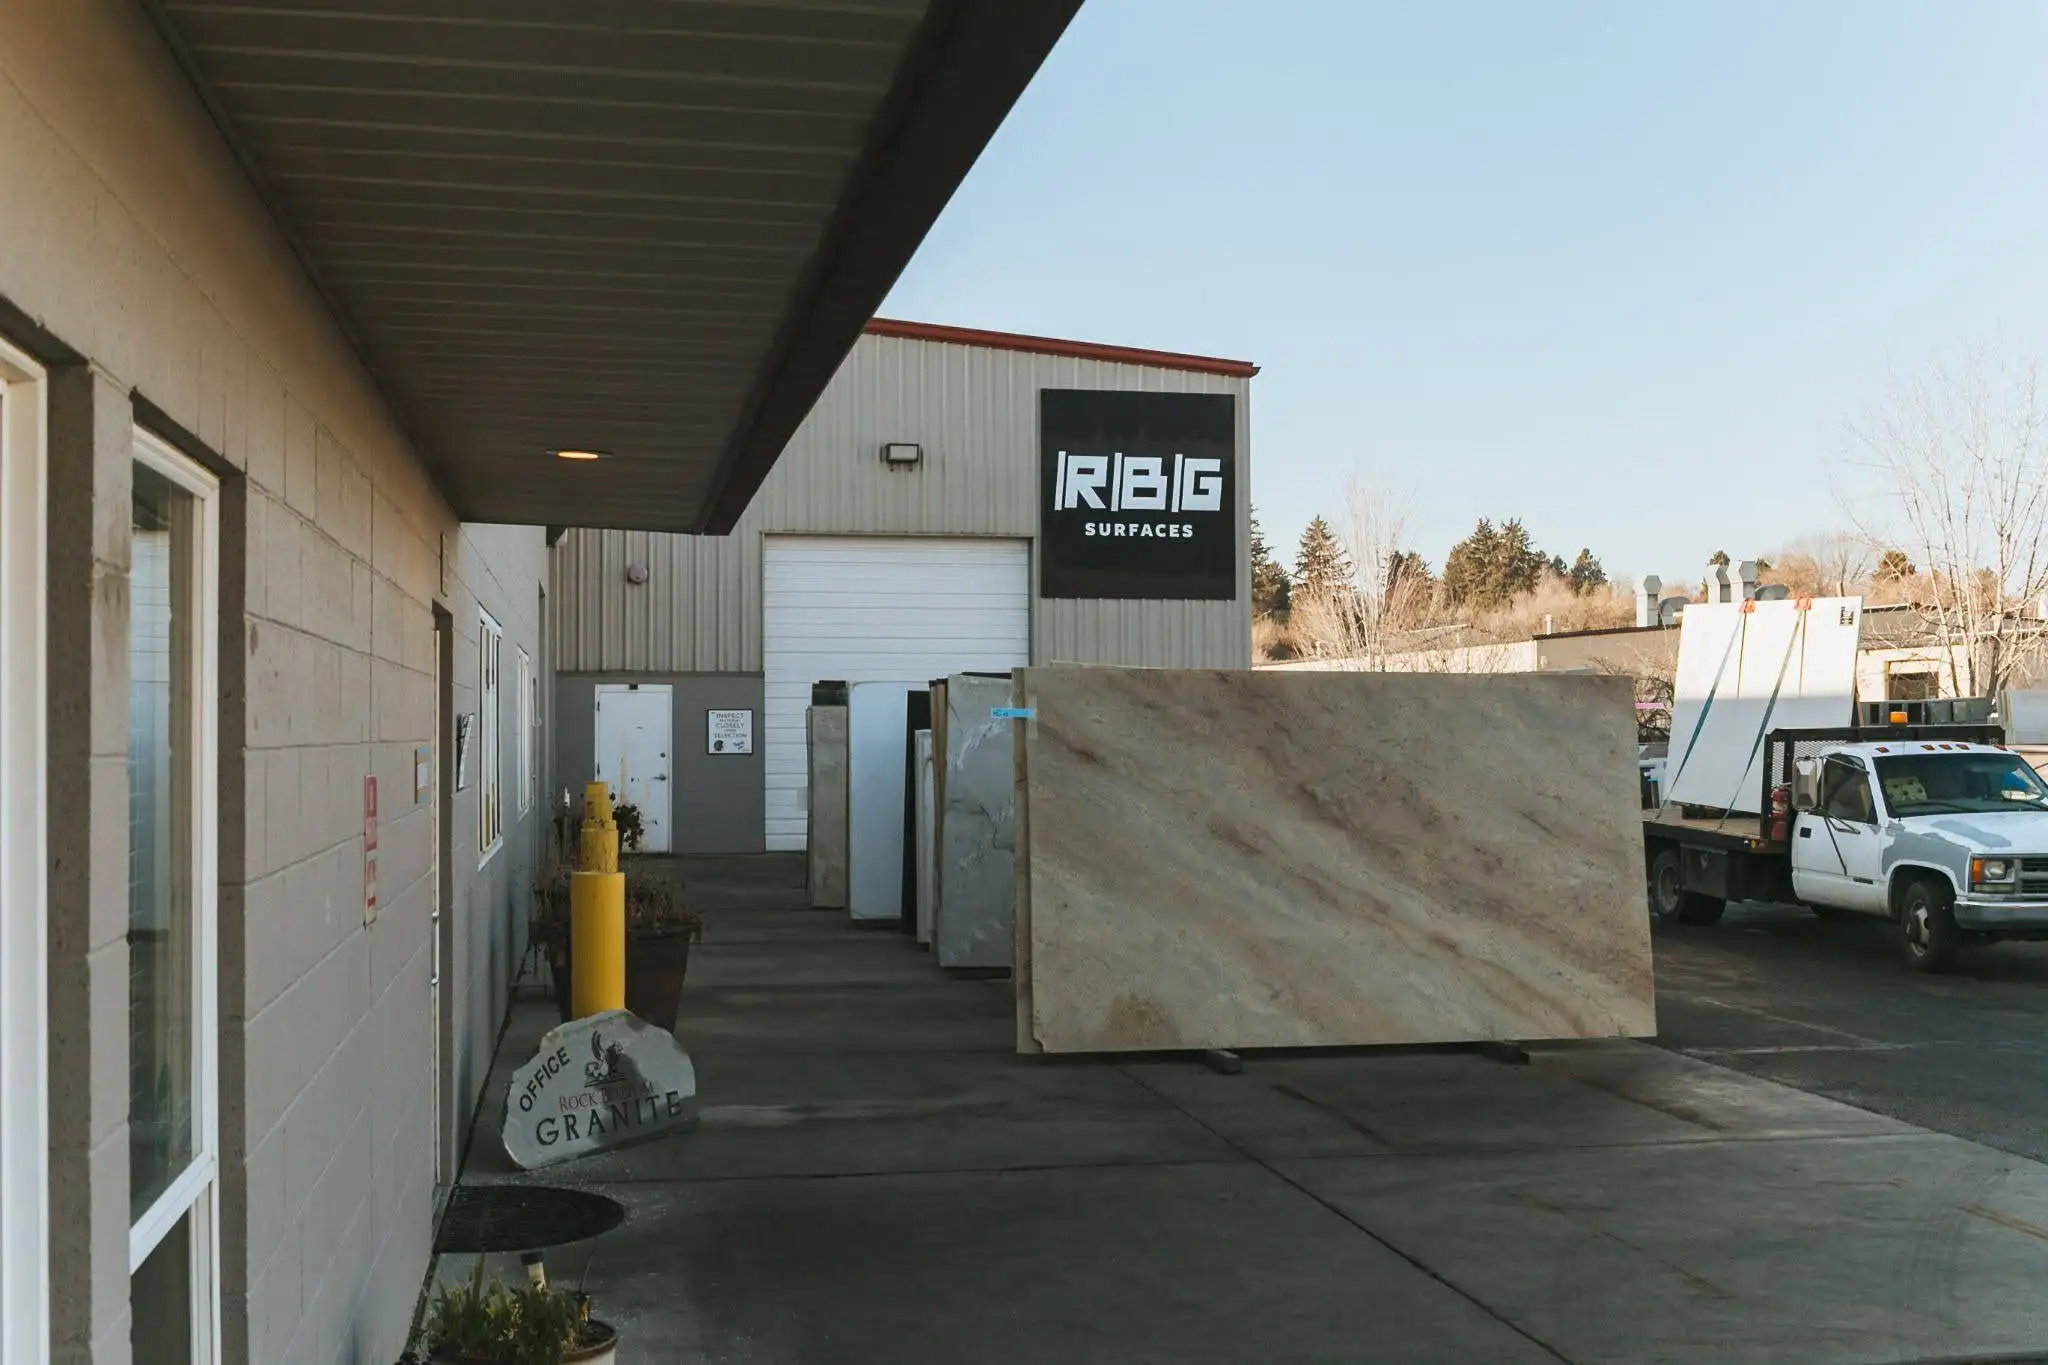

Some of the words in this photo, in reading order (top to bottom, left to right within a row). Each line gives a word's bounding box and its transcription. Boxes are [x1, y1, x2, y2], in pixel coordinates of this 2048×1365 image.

[1084, 522, 1194, 538] SURFACES
[519, 1046, 571, 1113] OFFICE
[535, 1090, 684, 1147] GRANITE
[558, 1091, 600, 1113] ROCK
